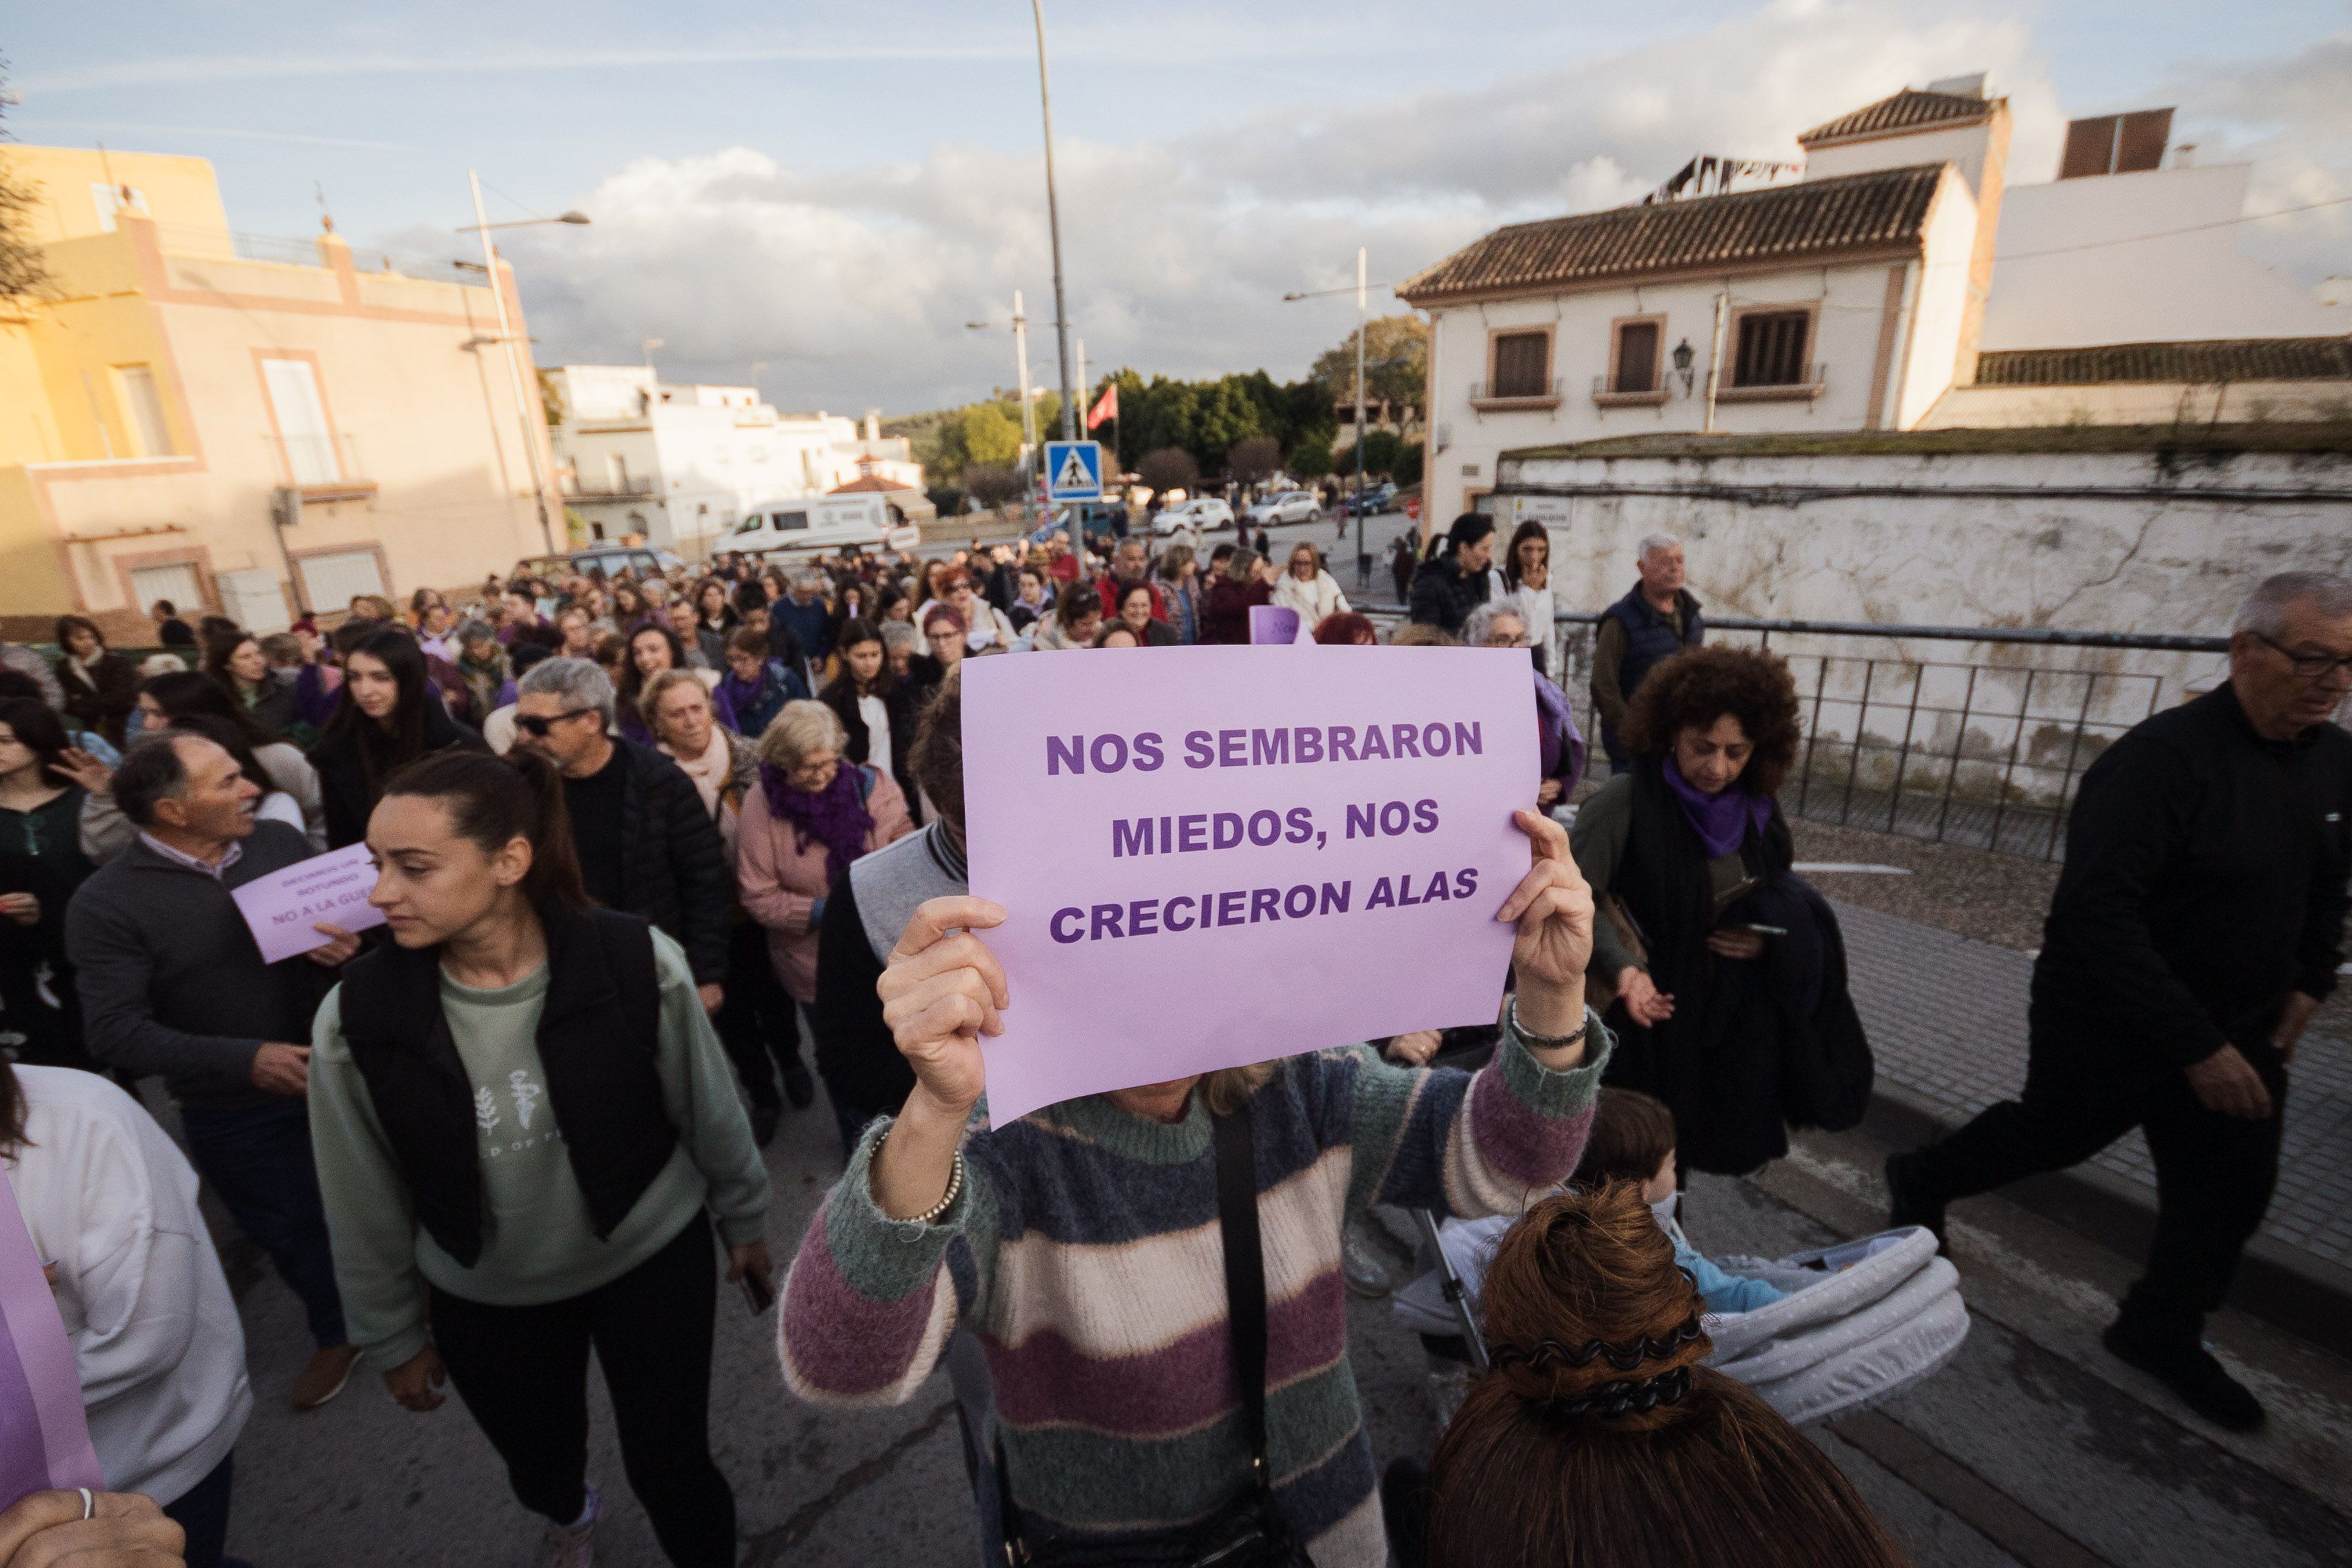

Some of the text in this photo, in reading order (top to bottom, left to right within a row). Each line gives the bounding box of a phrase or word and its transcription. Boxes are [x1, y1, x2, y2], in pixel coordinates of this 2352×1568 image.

[1046, 721, 1482, 775] NOS SEMBRARON
[1113, 798, 1439, 857] MIEDOS, NOS
[273, 910, 297, 924] NO
[302, 906, 313, 916] A
[315, 899, 335, 912] LA
[1050, 868, 1478, 943] CRECIERON ALAS
